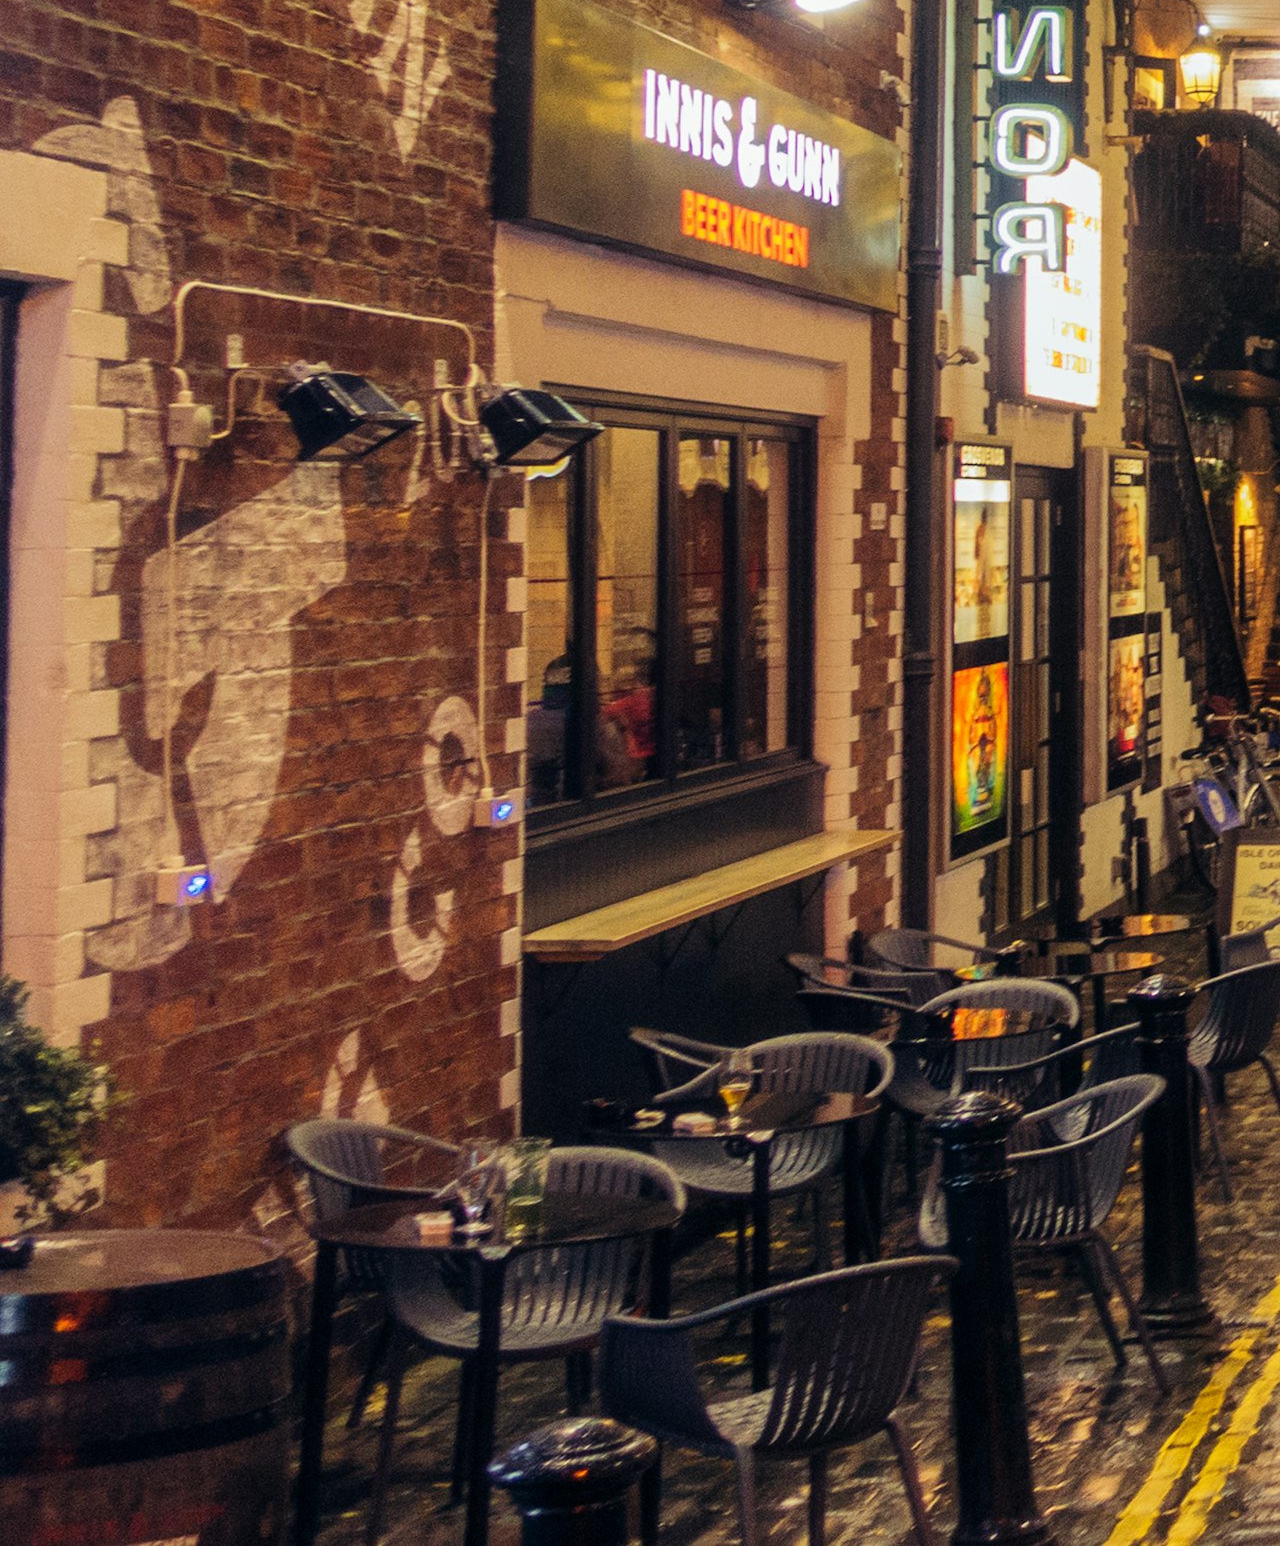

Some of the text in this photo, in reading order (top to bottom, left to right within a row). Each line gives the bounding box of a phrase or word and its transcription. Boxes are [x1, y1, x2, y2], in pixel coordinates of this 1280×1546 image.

[644, 68, 840, 207] INNIS & GUNN
[680, 189, 810, 269] BEER KITCHEN
[1239, 849, 1264, 858] ISLE
